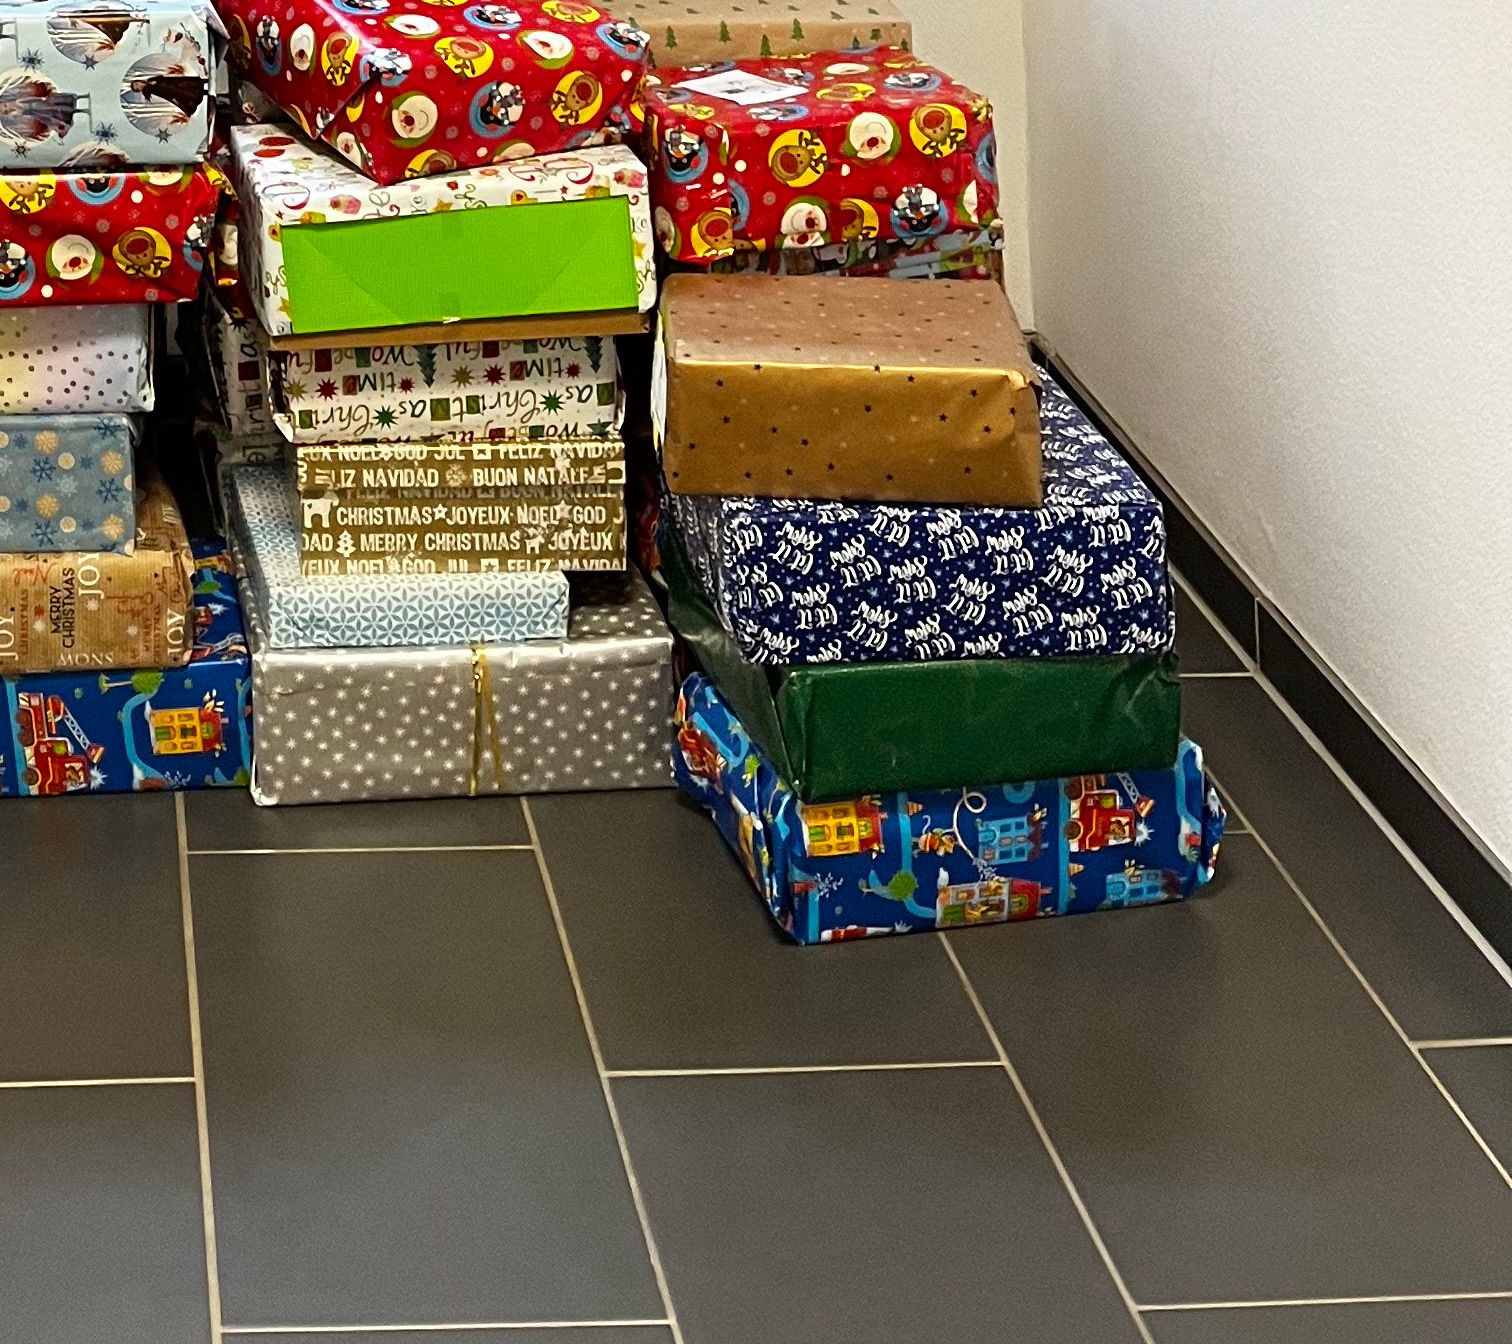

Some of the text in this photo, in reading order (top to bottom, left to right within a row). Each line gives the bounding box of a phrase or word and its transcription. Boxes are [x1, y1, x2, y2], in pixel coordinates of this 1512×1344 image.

[363, 467, 439, 488] NAVIDAD
[472, 467, 518, 486] BUON
[336, 506, 433, 526] CHRISTMAS
[446, 505, 511, 526] JOYEUX
[572, 505, 606, 525] GOD
[360, 532, 418, 552] MERRY
[424, 532, 520, 551] CHRISTMAS
[77, 553, 105, 600] JOY
[49, 585, 62, 634] MERRY
[62, 567, 75, 649] CHRISTMAS
